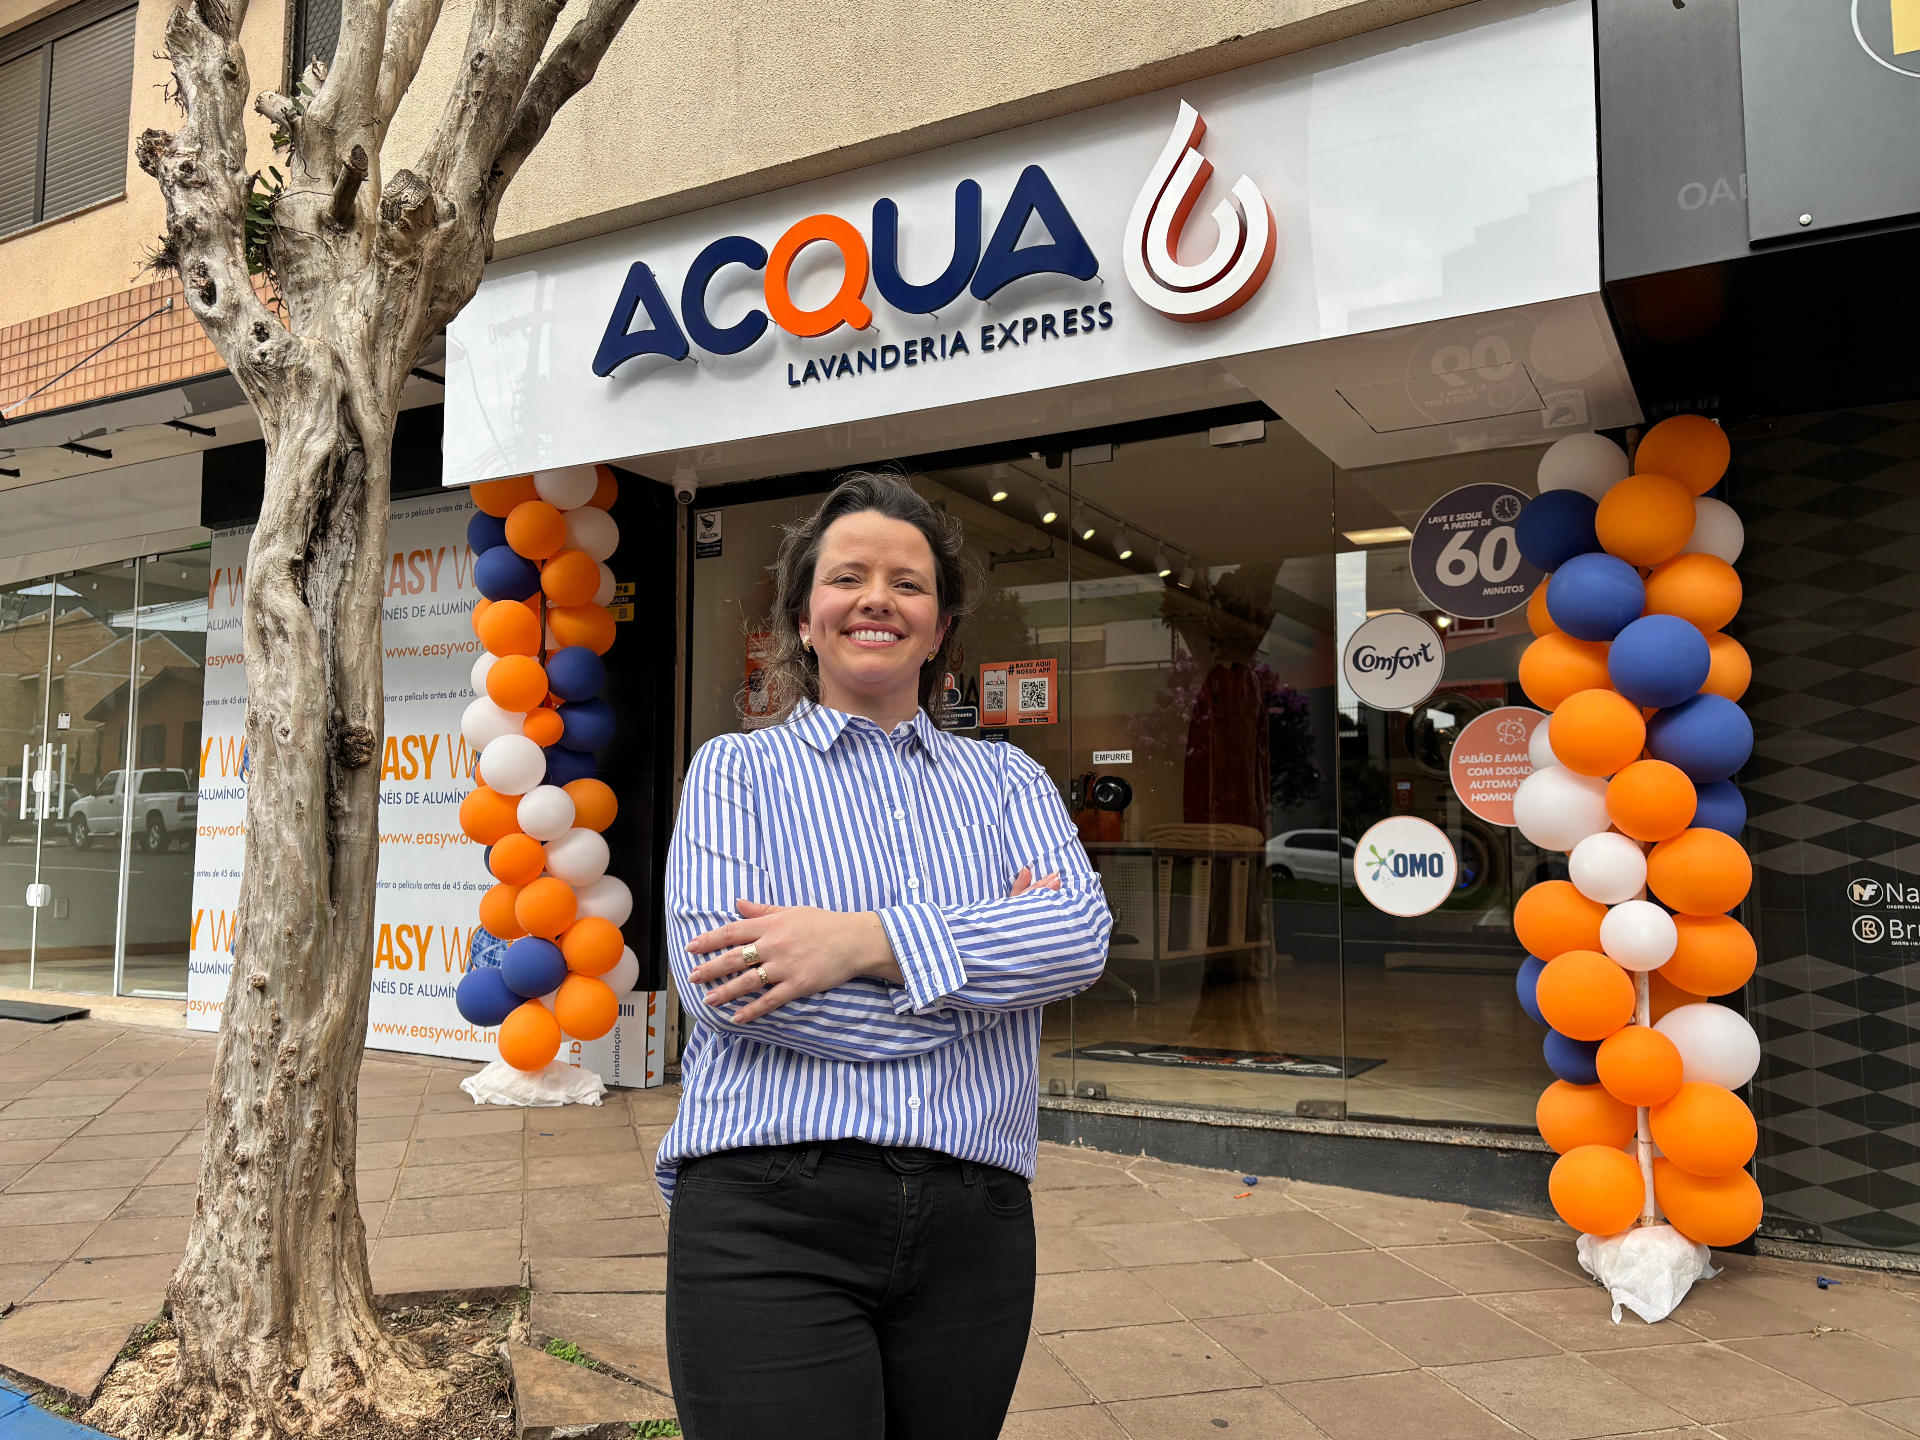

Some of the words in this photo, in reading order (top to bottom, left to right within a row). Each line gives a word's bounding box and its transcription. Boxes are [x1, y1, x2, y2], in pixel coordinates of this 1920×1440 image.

[592, 164, 1099, 379] ACQUA
[788, 331, 969, 387] LAVANDERIA
[981, 302, 1114, 350] EXPRESS
[436, 504, 453, 512] antes
[455, 502, 463, 510] de
[465, 500, 474, 509] 45
[1428, 515, 1447, 524] LAVE
[1449, 514, 1454, 522] E
[1456, 511, 1483, 521] SEQUE
[1443, 523, 1450, 531] A
[1451, 520, 1479, 530] PARTIR
[1481, 518, 1492, 526] DE
[1436, 526, 1521, 587] 60
[384, 547, 446, 597] ASY
[1482, 585, 1525, 596] MINUTOS
[382, 605, 408, 621] INÉIS
[412, 605, 425, 618] DE
[207, 615, 242, 631] ALUMÍN
[385, 640, 484, 658] www.easywor
[206, 653, 244, 669] asywo
[1352, 642, 1434, 680] Comfort
[384, 694, 398, 702] tirar
[449, 690, 457, 698] de
[459, 689, 467, 698] 45
[381, 734, 440, 781] ASY
[1094, 753, 1130, 761] EMPURRE
[1458, 752, 1493, 764] SABÃO
[1495, 754, 1502, 763] E
[1503, 753, 1530, 762] AMA
[1467, 767, 1493, 776] COM
[1496, 766, 1533, 776] DOSAD
[198, 786, 245, 800] ALUMÍNIO
[379, 789, 402, 804] NÉIS
[405, 792, 419, 804] DE
[1471, 793, 1514, 802] HOMOL
[379, 833, 474, 849] www.easywo
[1393, 853, 1444, 878] OMO
[398, 880, 422, 891] película
[424, 882, 441, 890] antes
[443, 881, 451, 890] de
[453, 882, 461, 890] 45
[463, 881, 476, 890] dias
[1886, 882, 1920, 903] Na
[374, 924, 434, 971] ASY
[372, 978, 396, 994] NÉIS
[400, 983, 414, 995] DE
[417, 982, 458, 998] ALUMÍN
[372, 1022, 497, 1043] www.easywork.in
